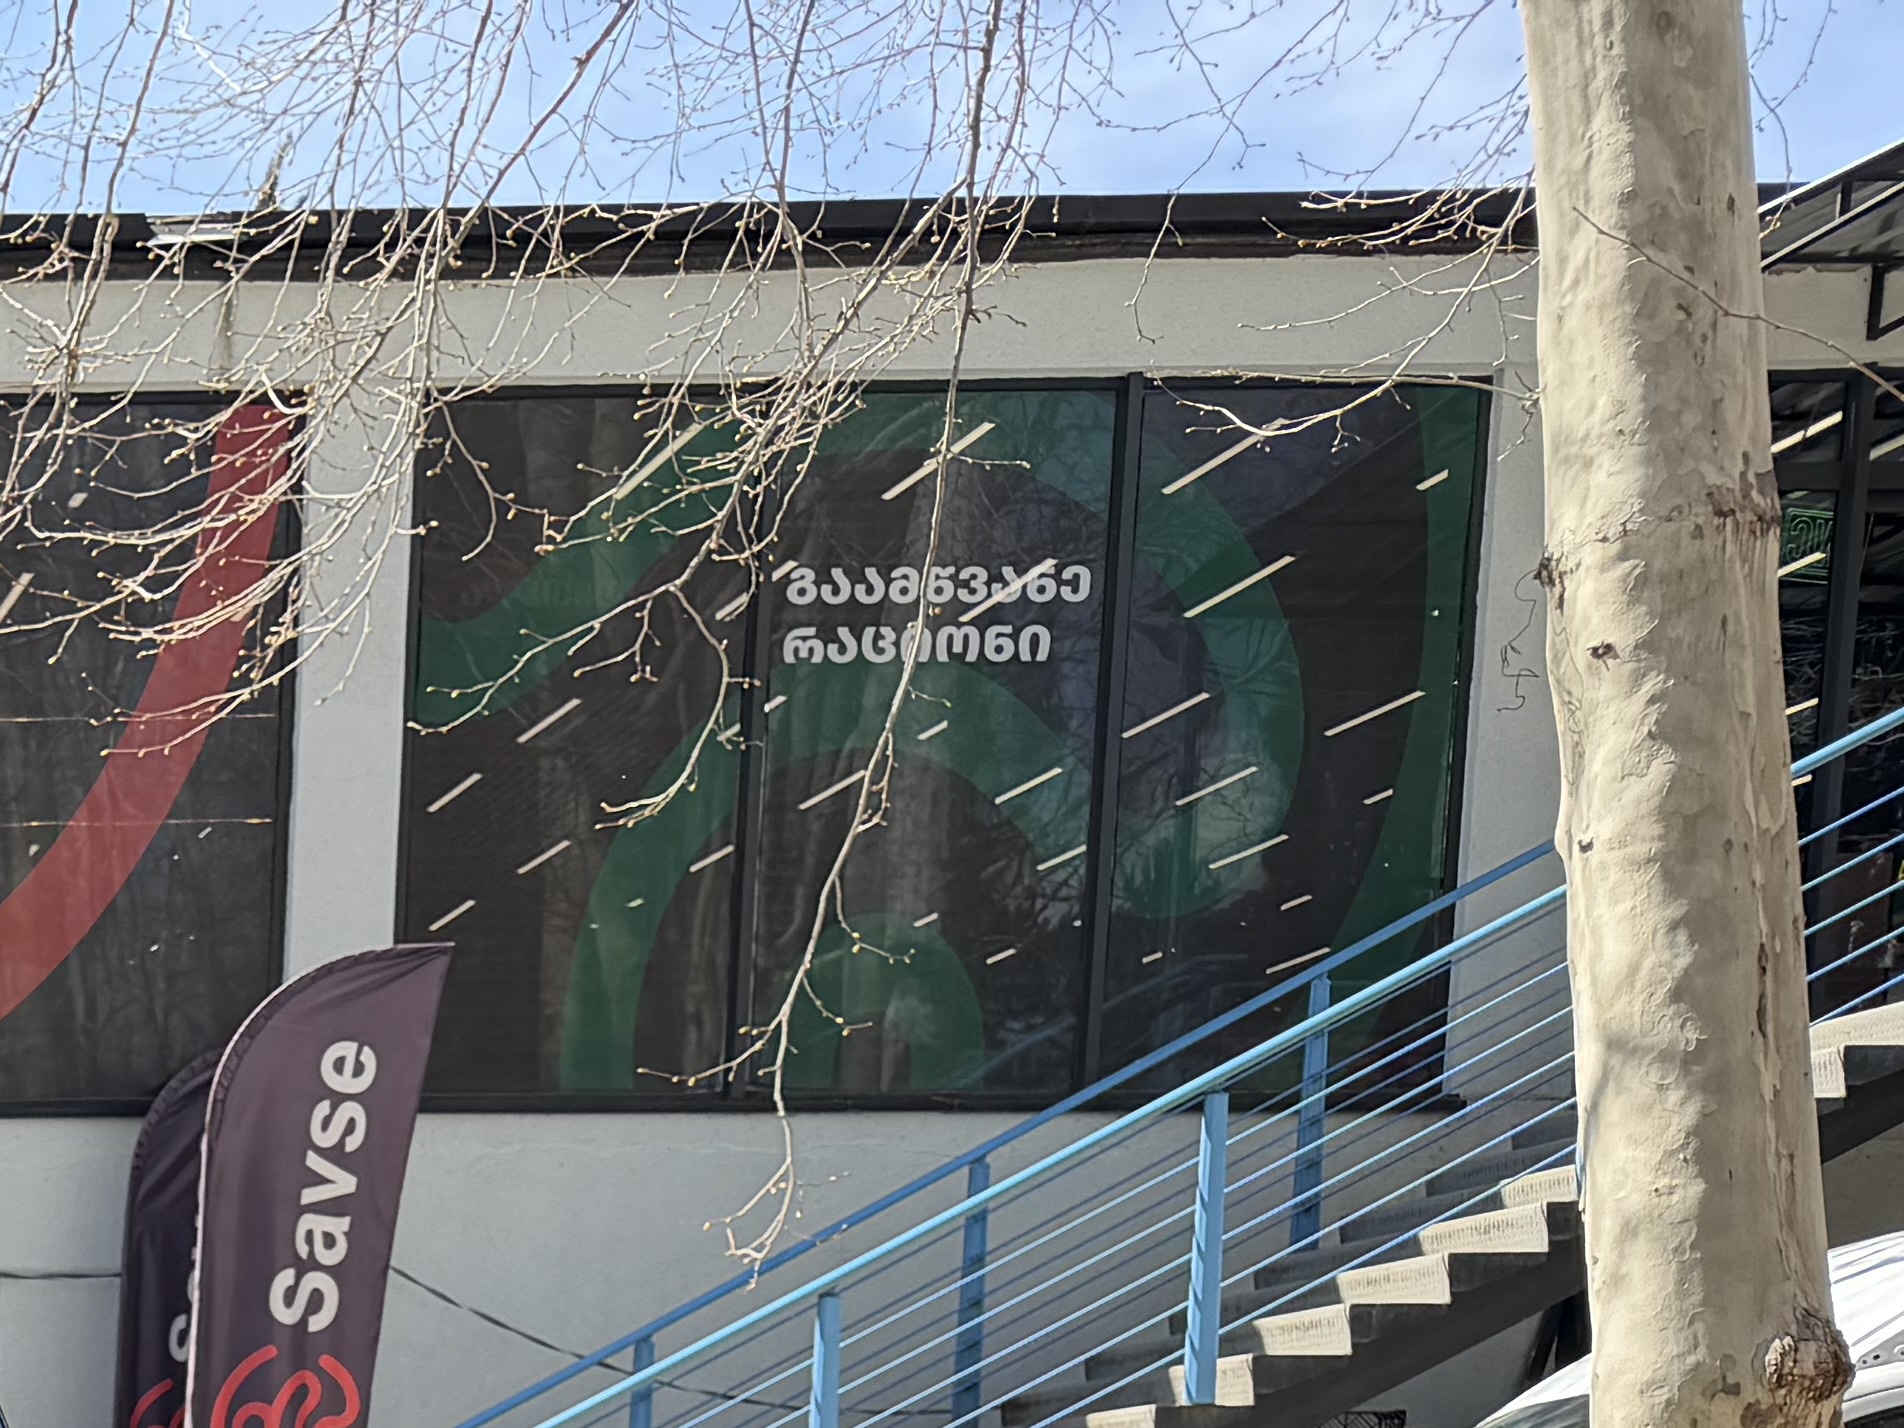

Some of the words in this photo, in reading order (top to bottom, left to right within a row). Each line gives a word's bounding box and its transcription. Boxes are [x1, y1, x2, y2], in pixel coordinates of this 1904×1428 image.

[785, 564, 1092, 606] გაამწვანე
[782, 624, 1052, 664] რაციონი
[269, 1039, 378, 1333] Savse
